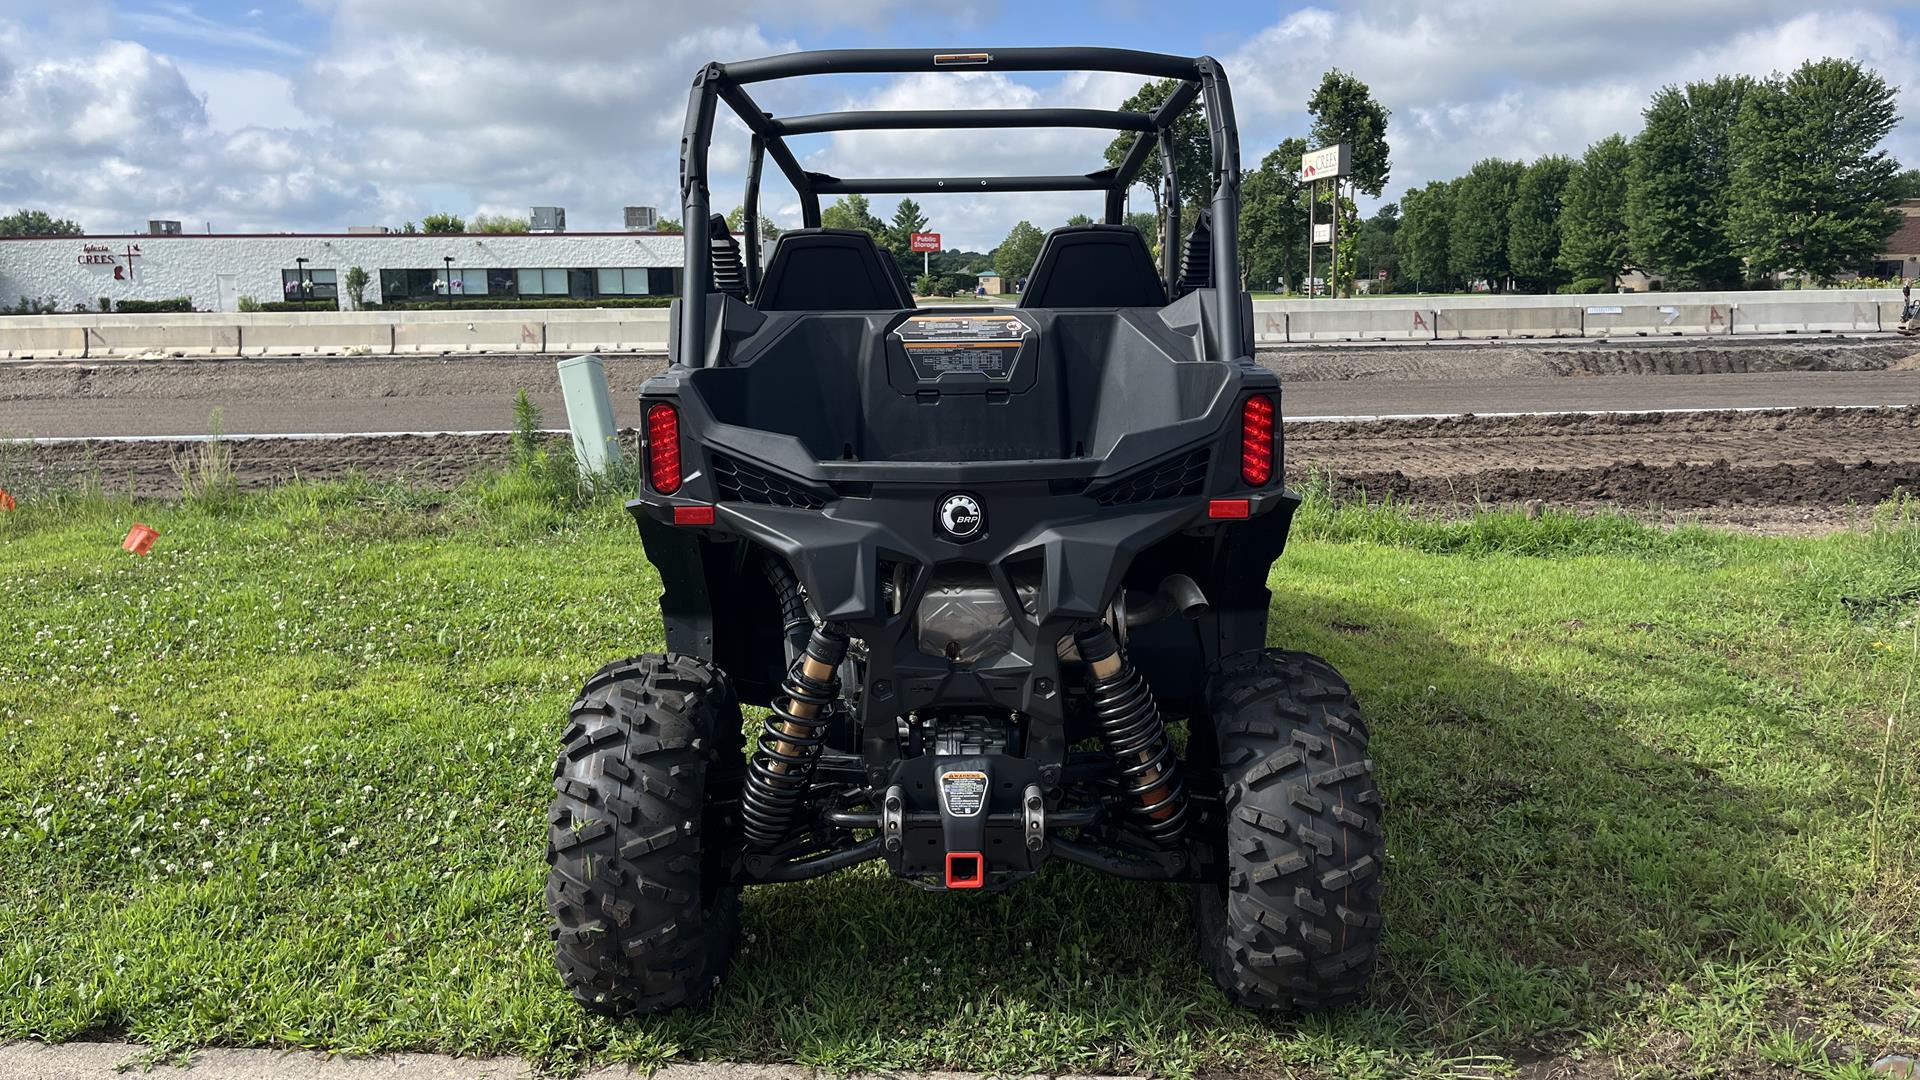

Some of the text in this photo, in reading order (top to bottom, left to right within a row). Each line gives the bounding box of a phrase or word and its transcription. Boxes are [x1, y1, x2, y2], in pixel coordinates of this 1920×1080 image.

[83, 244, 108, 253] Iglesia
[77, 255, 115, 264] CREES
[1710, 305, 1724, 325] A
[1412, 310, 1429, 332] A
[957, 516, 978, 524] BRP
